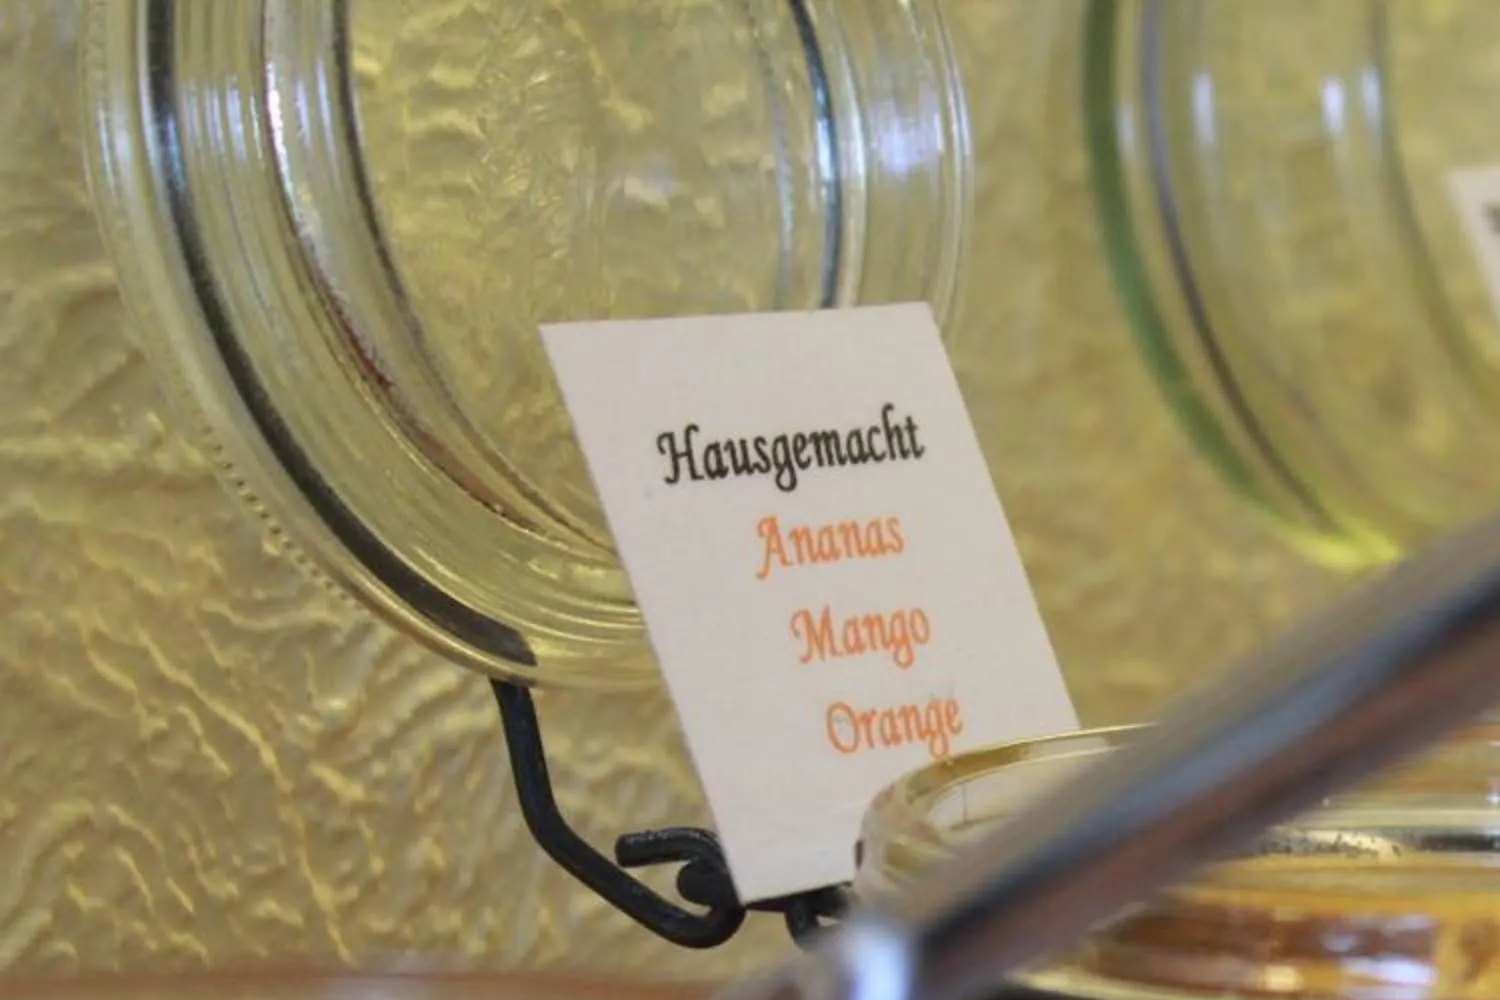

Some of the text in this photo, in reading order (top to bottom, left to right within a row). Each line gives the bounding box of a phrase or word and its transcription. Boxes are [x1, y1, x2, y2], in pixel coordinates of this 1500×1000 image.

[655, 403, 925, 493] Hausgemacht
[756, 515, 905, 580] Ananas
[790, 605, 931, 669] Mango
[826, 695, 963, 759] Orange
